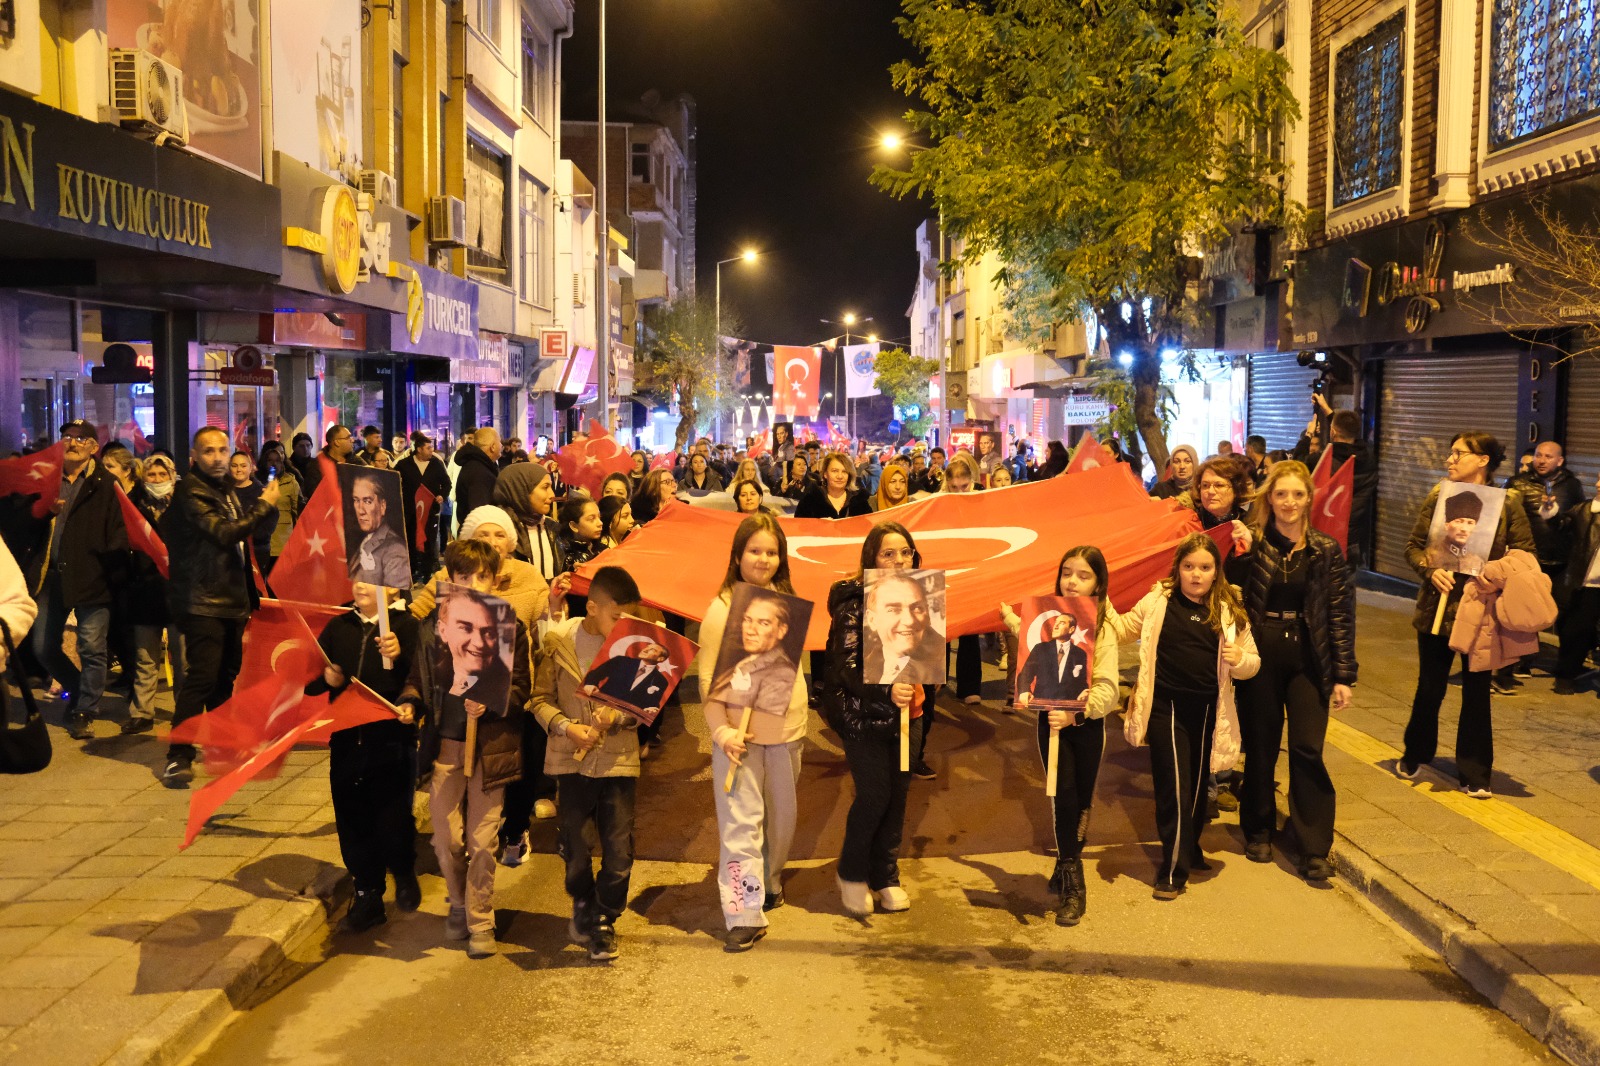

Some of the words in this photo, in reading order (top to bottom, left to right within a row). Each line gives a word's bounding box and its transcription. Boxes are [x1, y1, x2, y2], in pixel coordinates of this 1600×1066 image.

[57, 162, 212, 249] KUYUMCULUK
[426, 292, 474, 337] TURKCELL
[546, 335, 562, 353] E
[224, 373, 271, 384] vodafone
